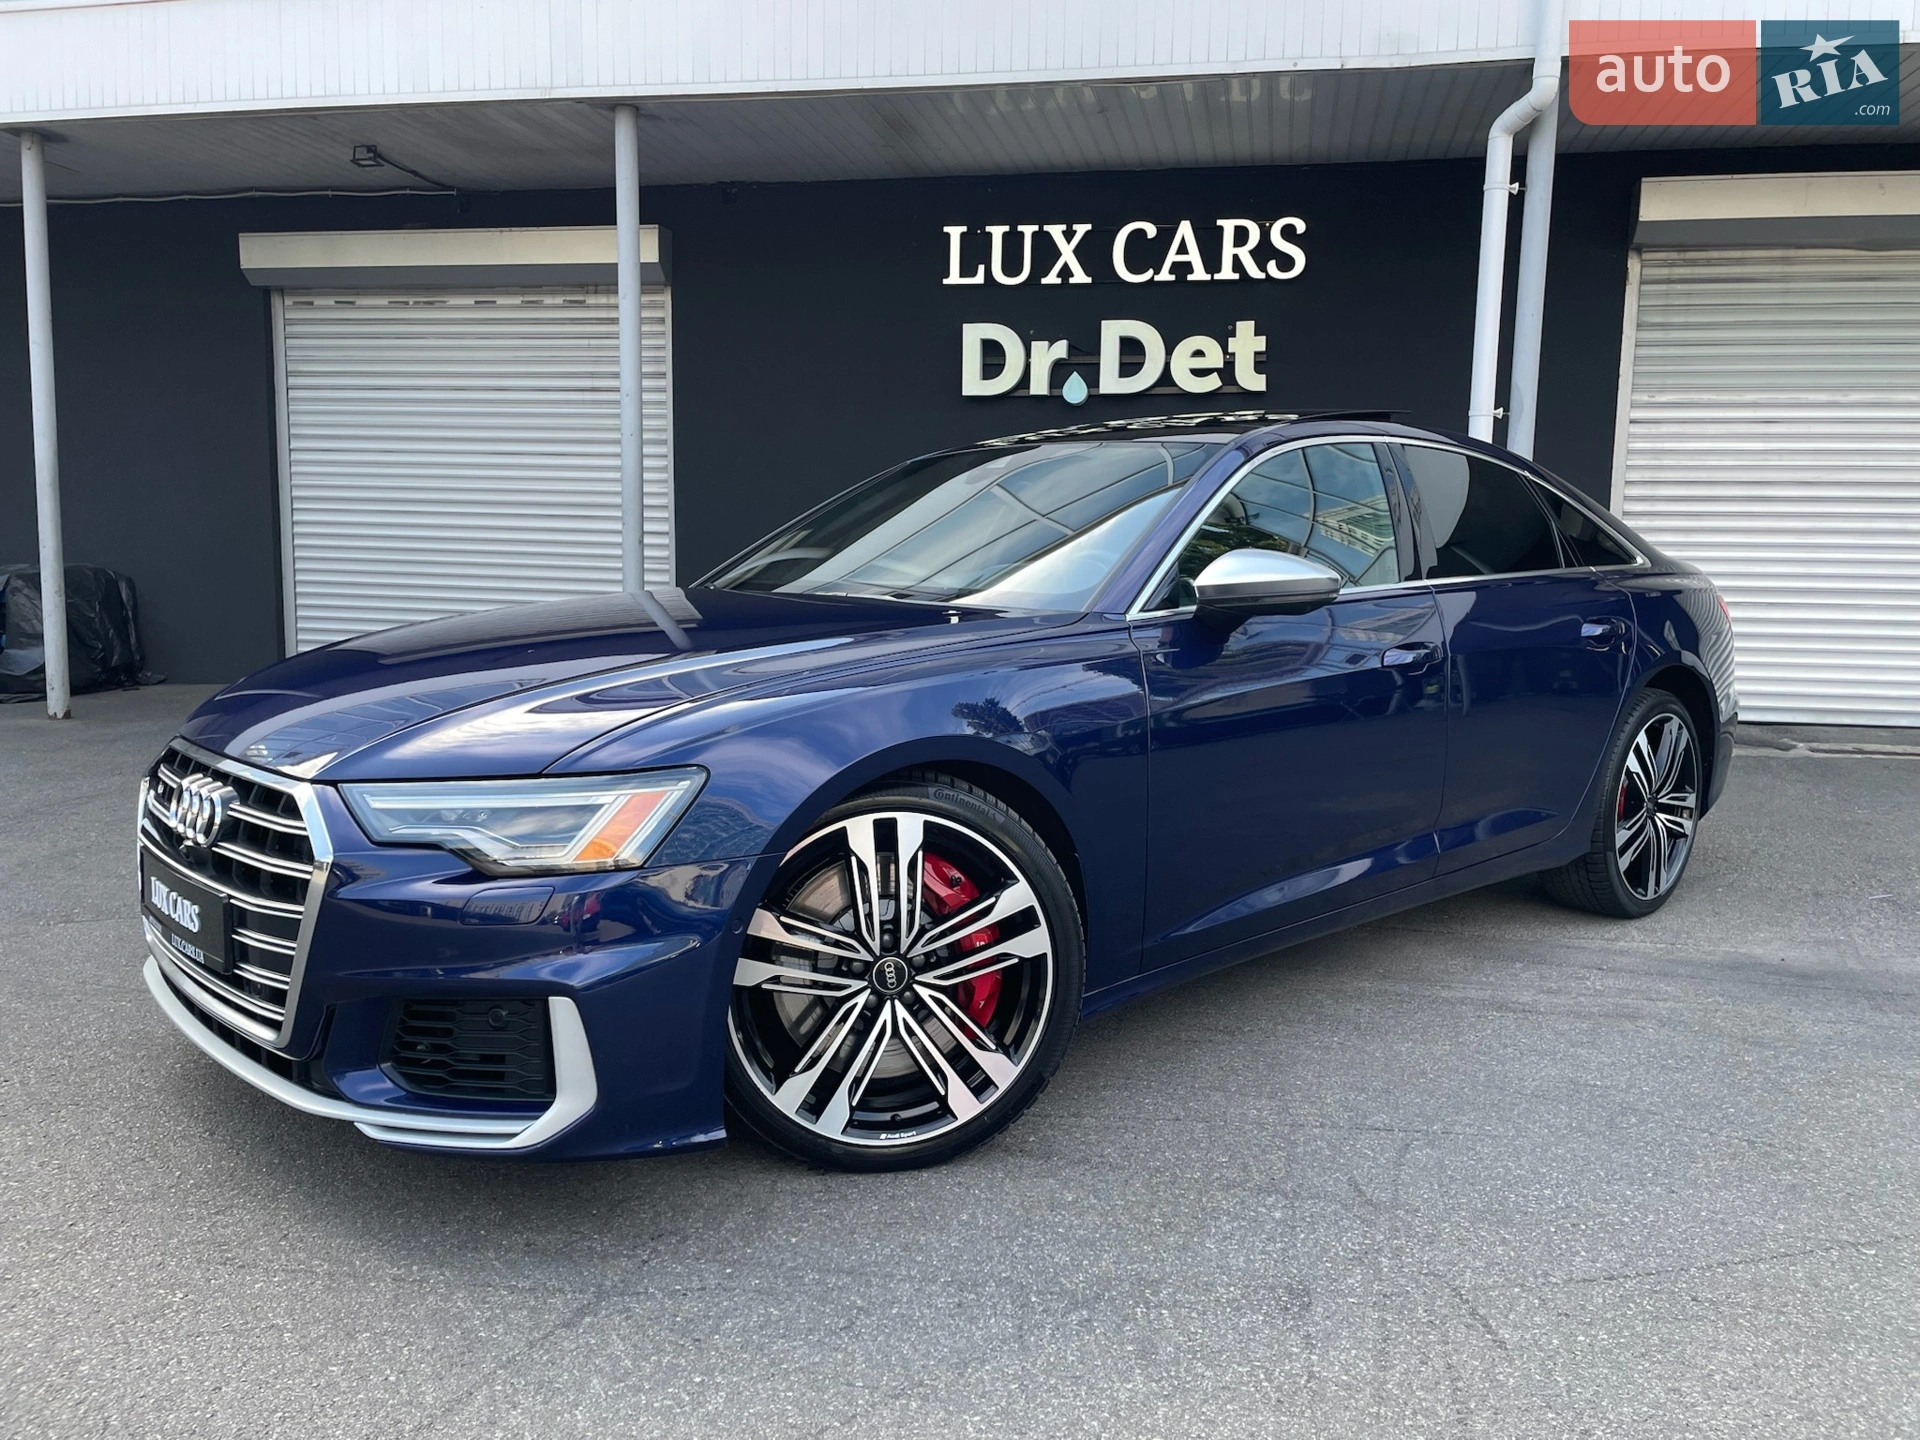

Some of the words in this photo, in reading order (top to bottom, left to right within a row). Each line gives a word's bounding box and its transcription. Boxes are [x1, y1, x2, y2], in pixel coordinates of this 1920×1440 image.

[942, 224, 1092, 285] LUX
[1112, 216, 1308, 283] CARS
[934, 788, 991, 817] Continental
[150, 876, 170, 915] LUX
[169, 891, 200, 932] CARS
